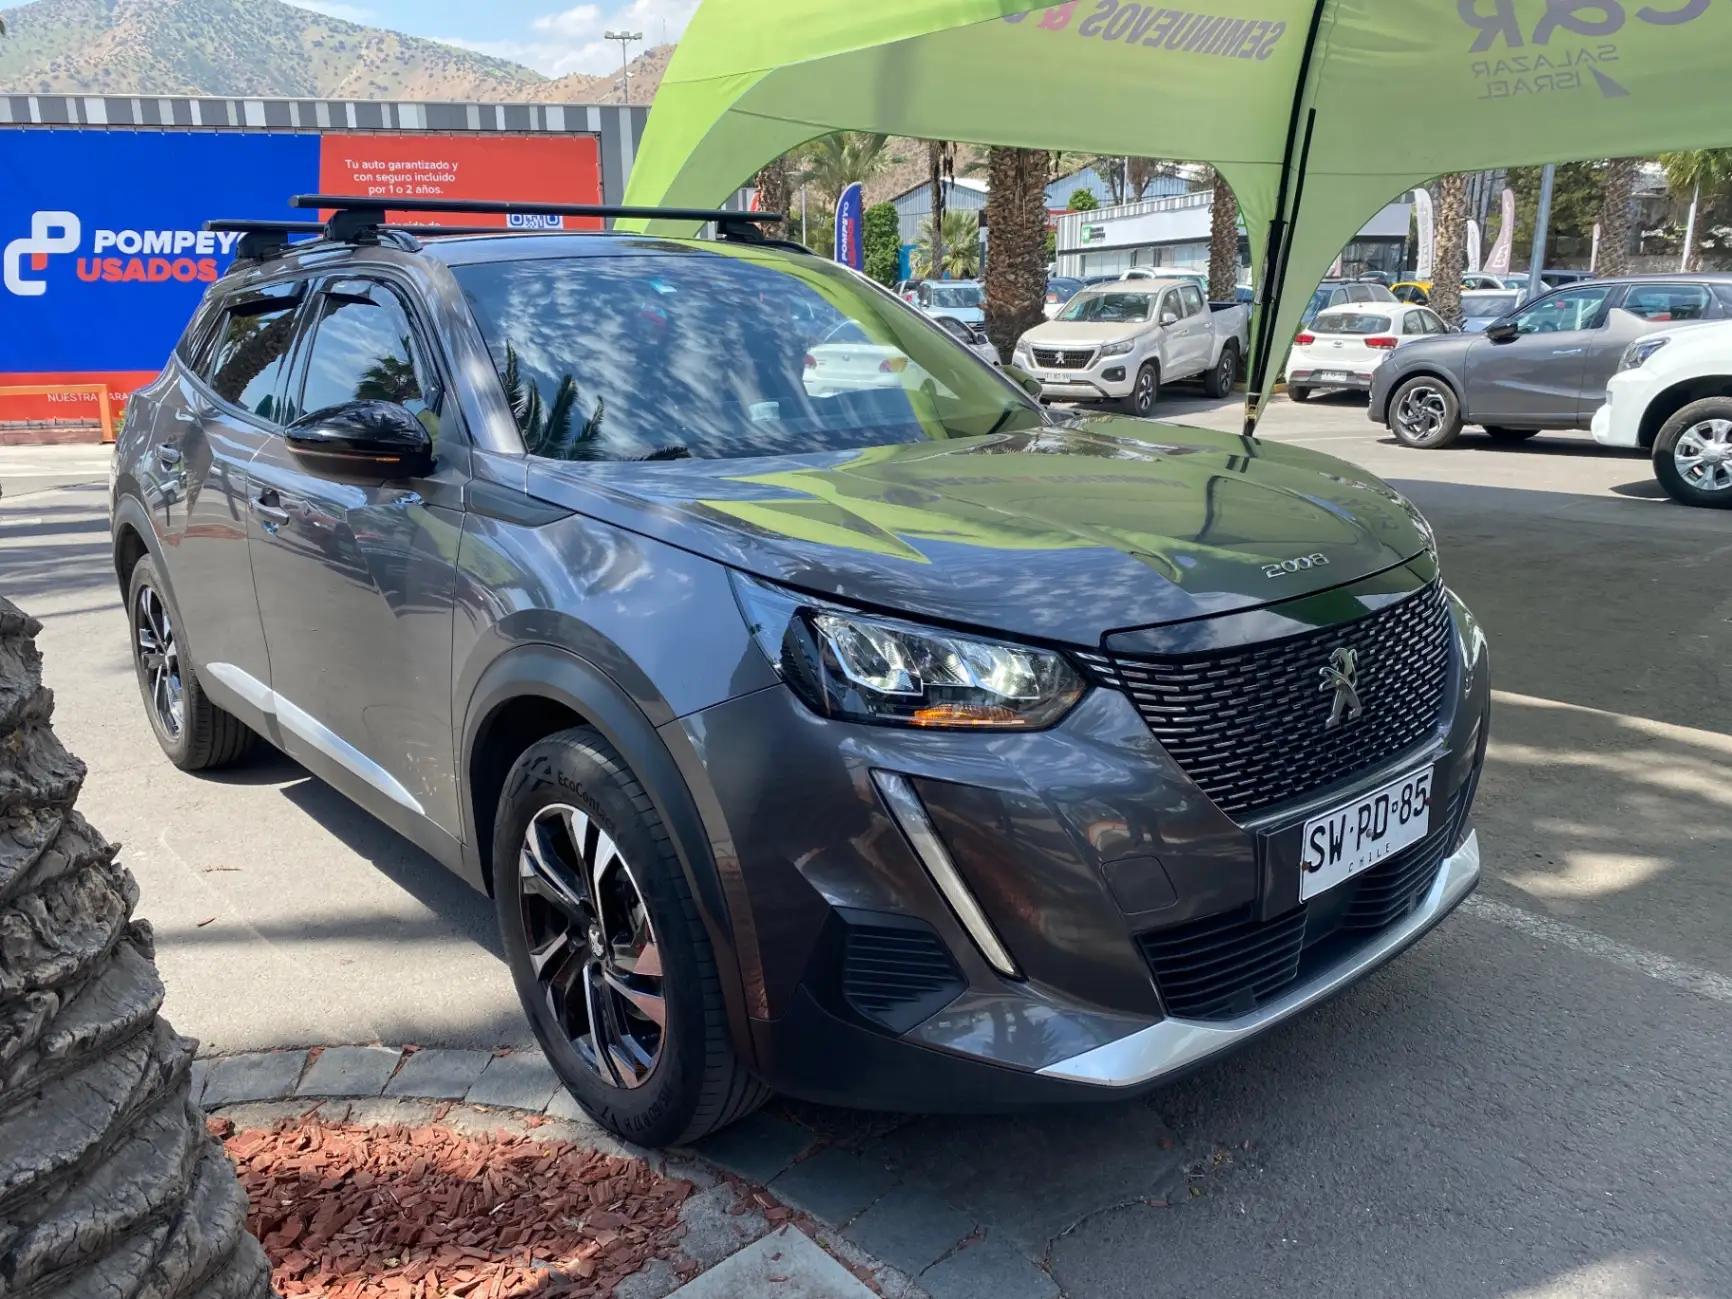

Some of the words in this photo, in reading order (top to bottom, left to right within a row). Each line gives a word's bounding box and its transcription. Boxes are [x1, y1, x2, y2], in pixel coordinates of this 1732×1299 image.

[345, 159, 359, 168] Tu
[362, 161, 386, 170] auto
[388, 160, 449, 171] garantizado
[452, 162, 458, 172] y
[353, 174, 373, 182] con
[376, 174, 411, 183] seguro
[414, 172, 455, 182] incluido
[368, 185, 385, 195] por
[389, 185, 394, 194] 1
[396, 186, 403, 194] o
[405, 184, 413, 194] 2
[415, 184, 444, 194] años.
[93, 230, 248, 255] POMPEY
[76, 257, 218, 282] USADOS
[47, 392, 98, 402] NUESTRA
[1261, 553, 1329, 578] 2008
